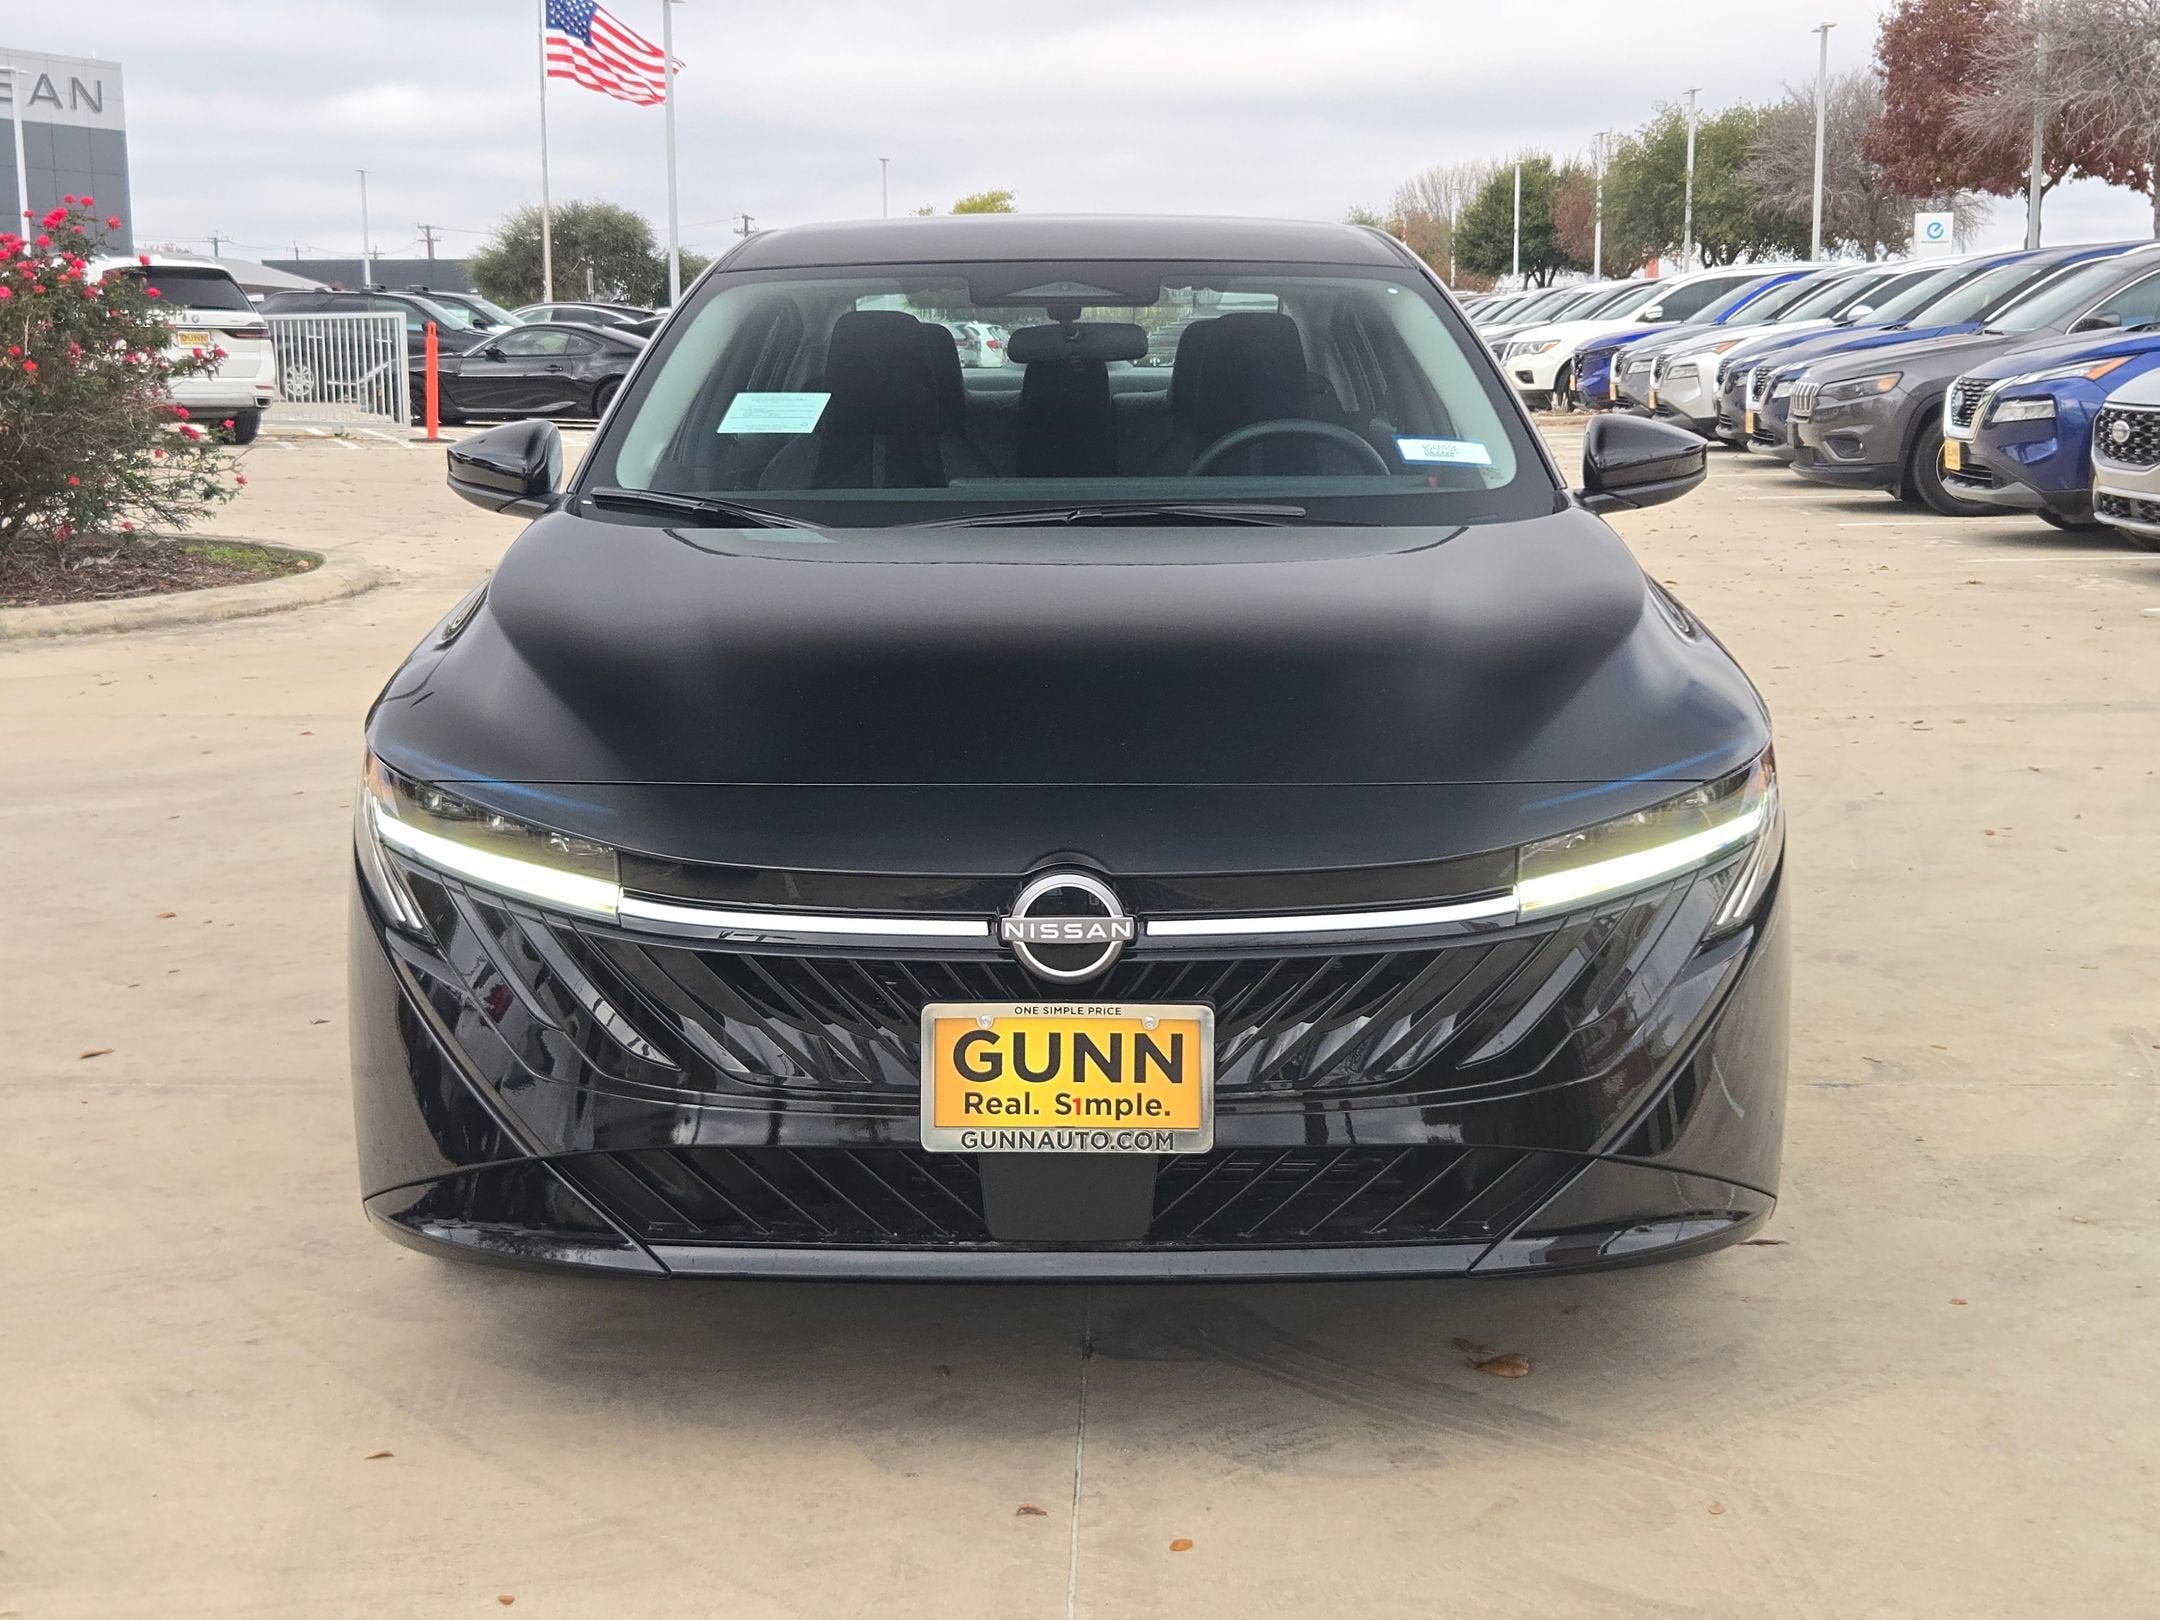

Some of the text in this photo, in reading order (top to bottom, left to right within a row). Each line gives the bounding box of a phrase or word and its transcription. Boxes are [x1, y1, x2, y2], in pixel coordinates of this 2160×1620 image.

[1004, 921, 1131, 939] NISSAN
[1014, 1006, 1122, 1016] ONE SIMPLE PRICE
[953, 1029, 1183, 1084] GUNN
[964, 1091, 1039, 1116] Real.
[960, 1130, 1174, 1151] GUNNAUTO.COM
